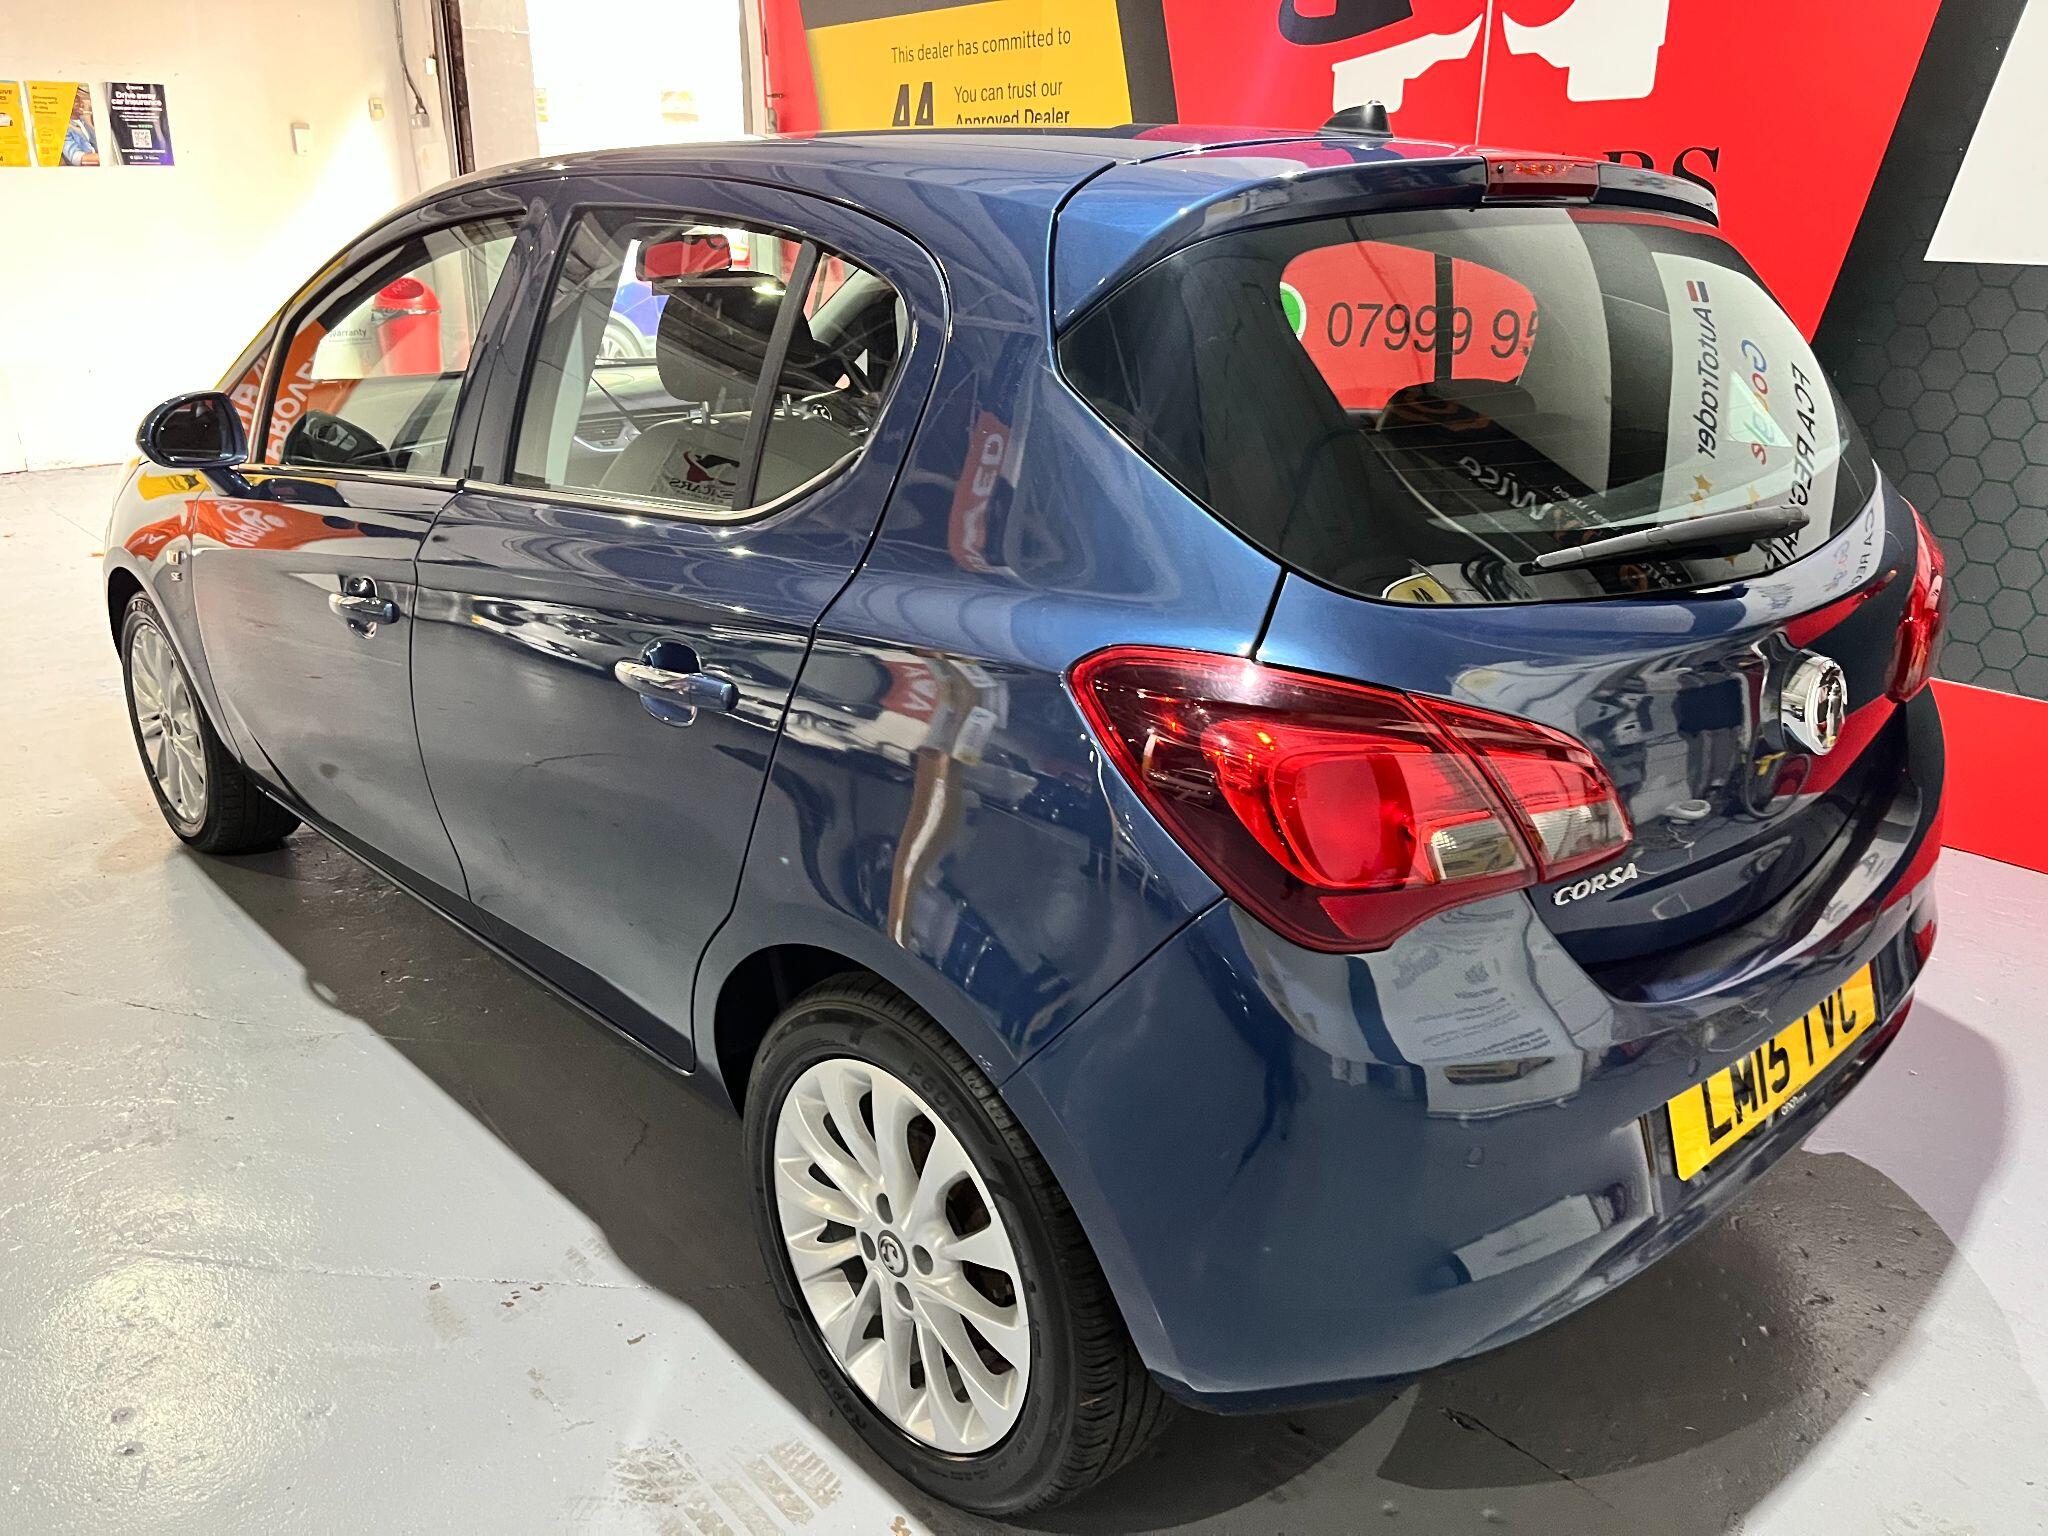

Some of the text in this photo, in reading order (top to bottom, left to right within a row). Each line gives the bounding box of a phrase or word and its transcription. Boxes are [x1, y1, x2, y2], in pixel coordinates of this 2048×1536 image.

[891, 27, 1072, 64] This dealer has committed to
[954, 80, 1063, 104] You can trust our
[1025, 107, 1070, 124] Dealer
[1327, 302, 1473, 355] 07999
[1553, 862, 1639, 907] CORSA
[1701, 1037, 1790, 1146] LM15
